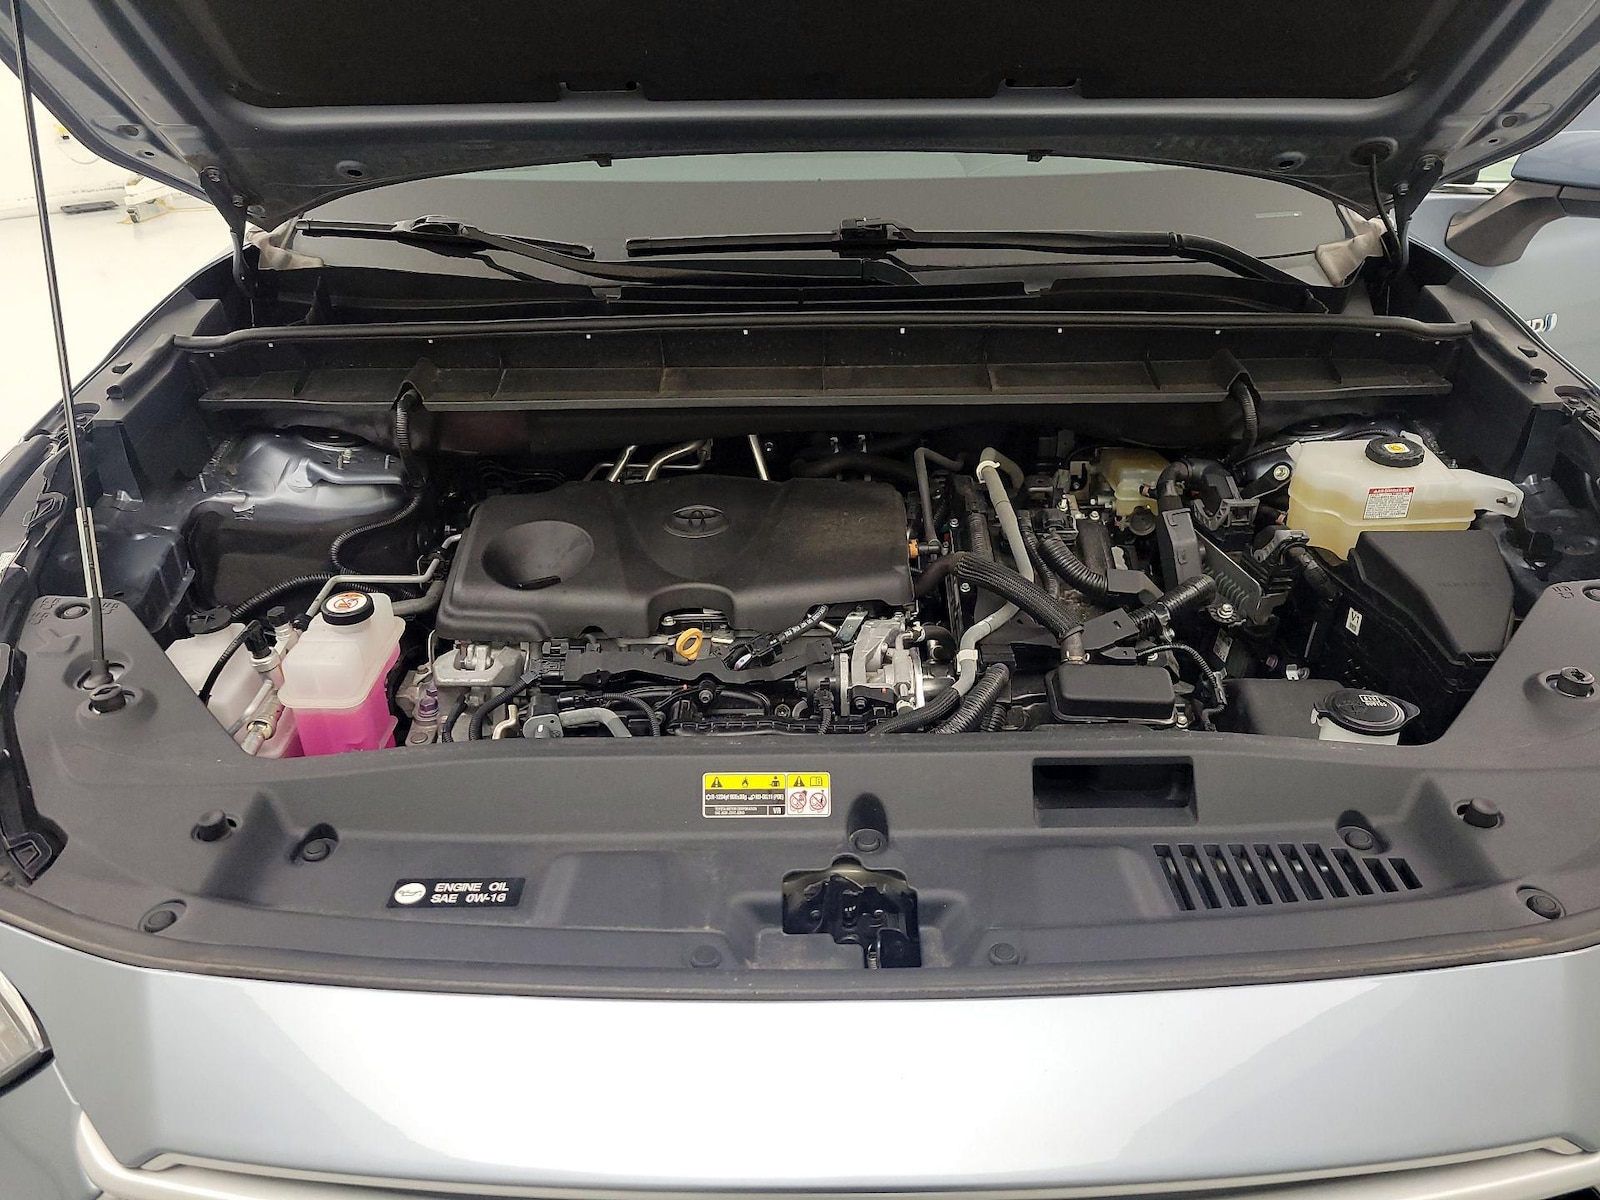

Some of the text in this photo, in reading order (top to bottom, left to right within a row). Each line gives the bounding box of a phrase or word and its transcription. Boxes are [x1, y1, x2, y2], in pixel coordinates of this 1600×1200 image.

[434, 882, 509, 892] ENGINE OIL
[430, 893, 506, 903] SAE 0W-16
